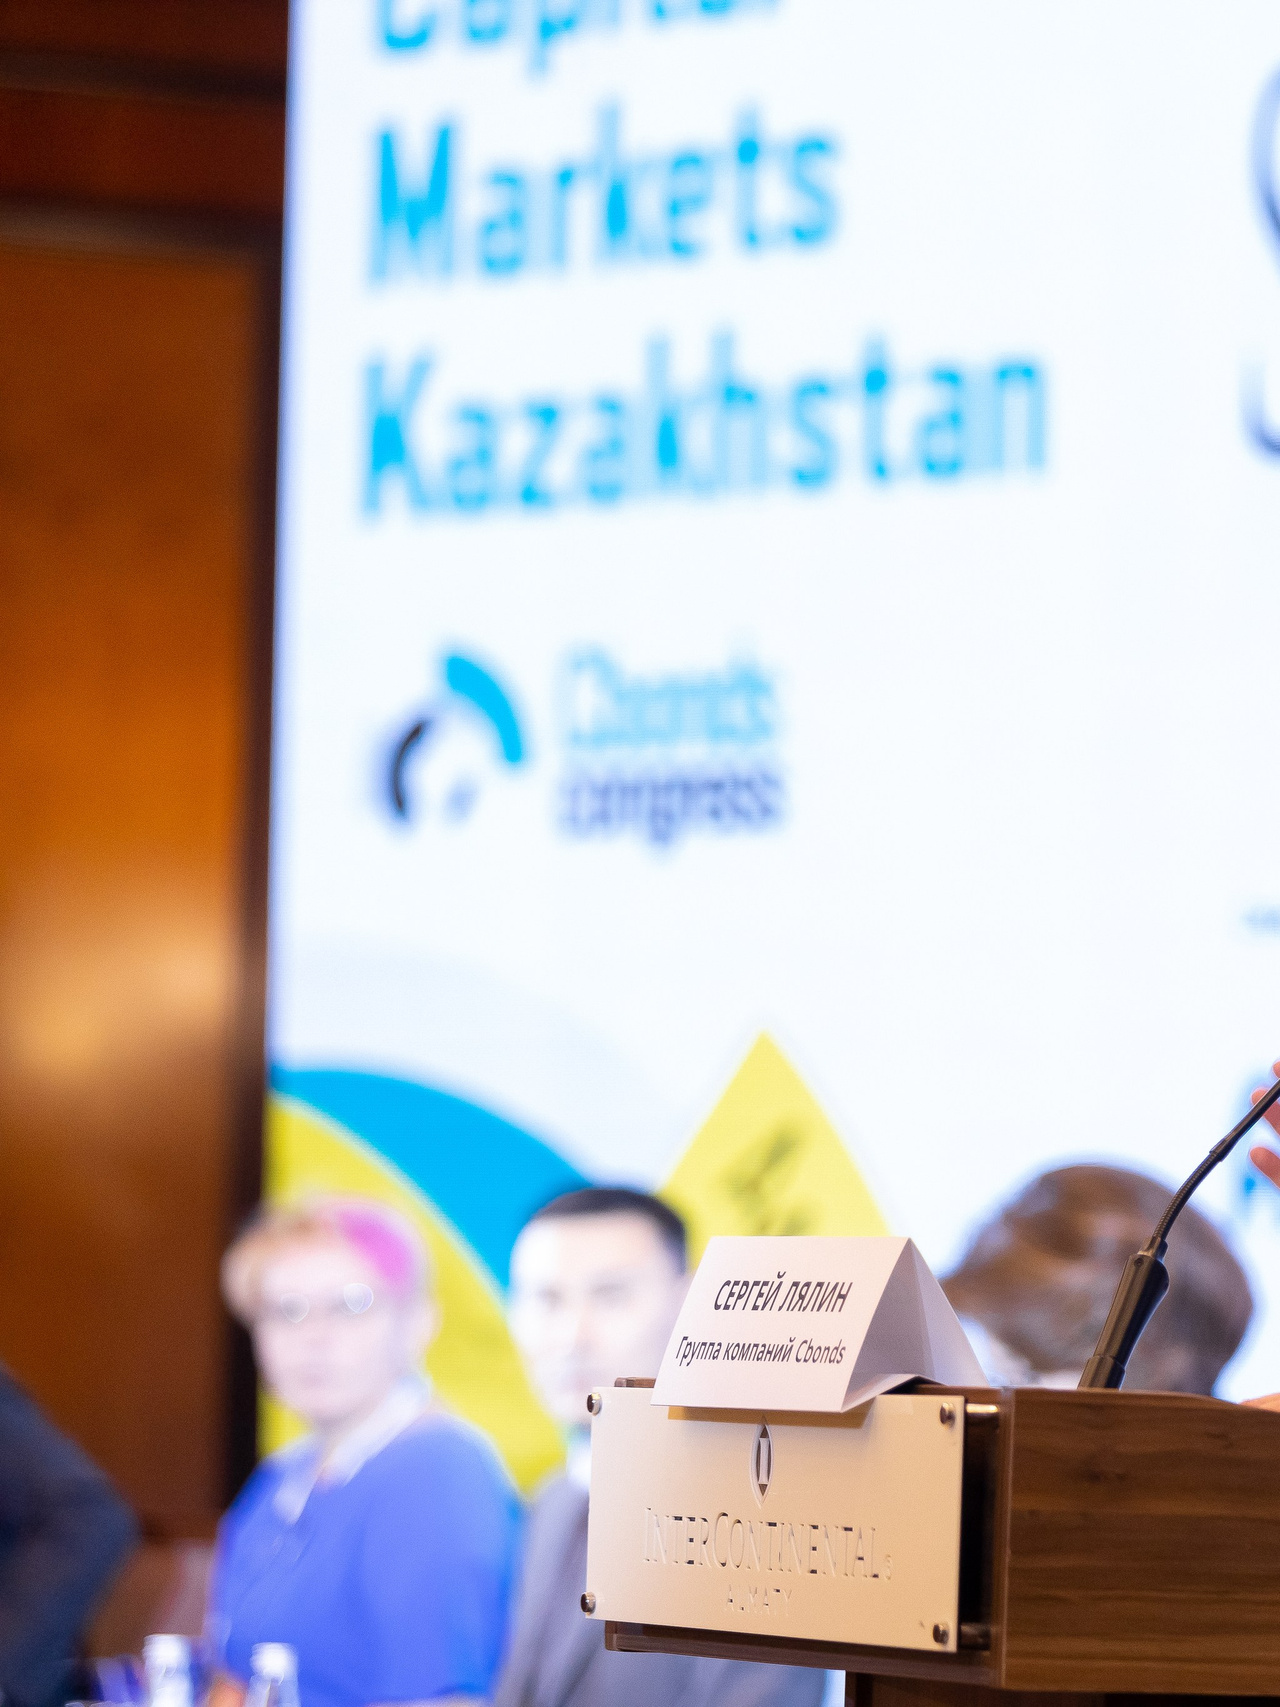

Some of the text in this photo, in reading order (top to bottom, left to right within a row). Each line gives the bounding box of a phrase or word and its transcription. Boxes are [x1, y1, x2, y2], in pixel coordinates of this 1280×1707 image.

[366, 105, 838, 287] Markets
[360, 334, 1046, 524] Kazakhstan
[713, 1270, 854, 1313] СЕРГЕЙ ЛЯЛИН
[675, 1335, 847, 1367] Группа компаний Cbonds
